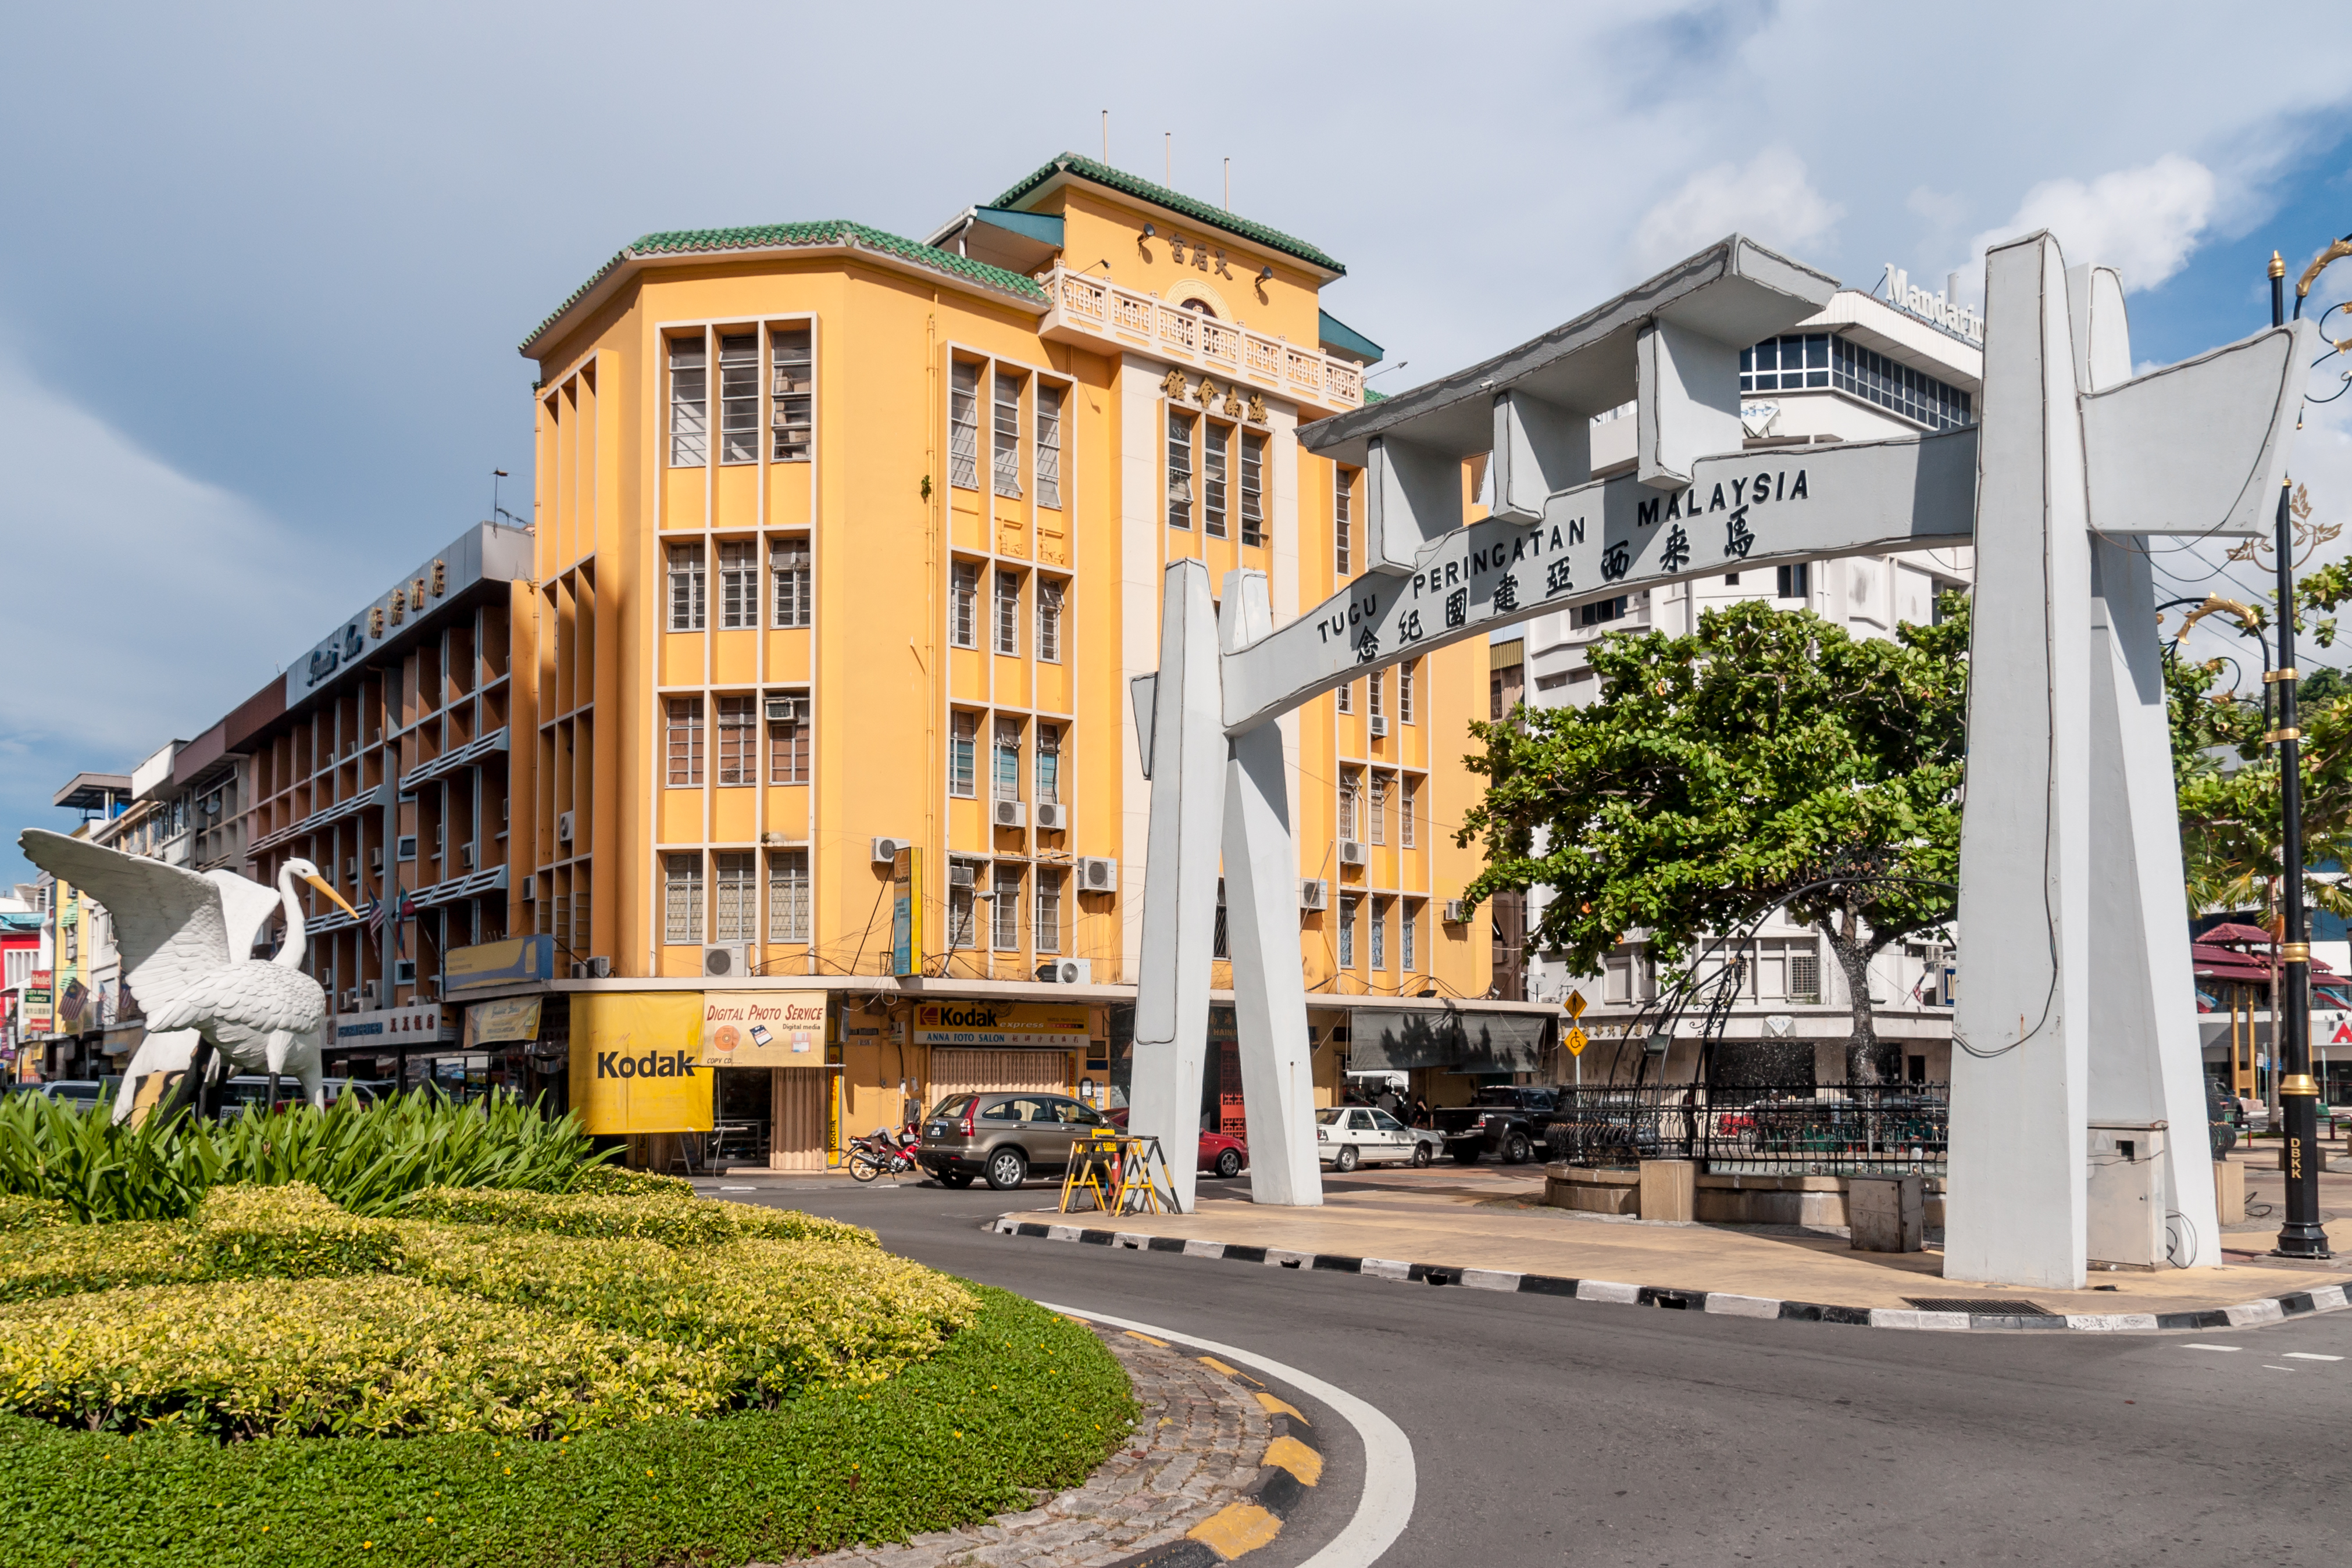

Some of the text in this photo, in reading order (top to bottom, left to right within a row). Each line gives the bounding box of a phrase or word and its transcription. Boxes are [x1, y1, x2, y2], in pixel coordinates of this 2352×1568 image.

[1885, 263, 1984, 344] Mandarin
[1317, 469, 1809, 643] TUGU PERINGATAN MALAYSIA
[895, 875, 909, 884] Kodak
[32, 974, 51, 985] Hotel
[706, 1003, 823, 1021] DIGITAL PHOTO SERVICE
[940, 1007, 997, 1027] Kodak
[927, 1033, 1005, 1042] ANNA FOTO SALON
[597, 1050, 695, 1078] Kodak
[2291, 1138, 2302, 1178] DBKK
